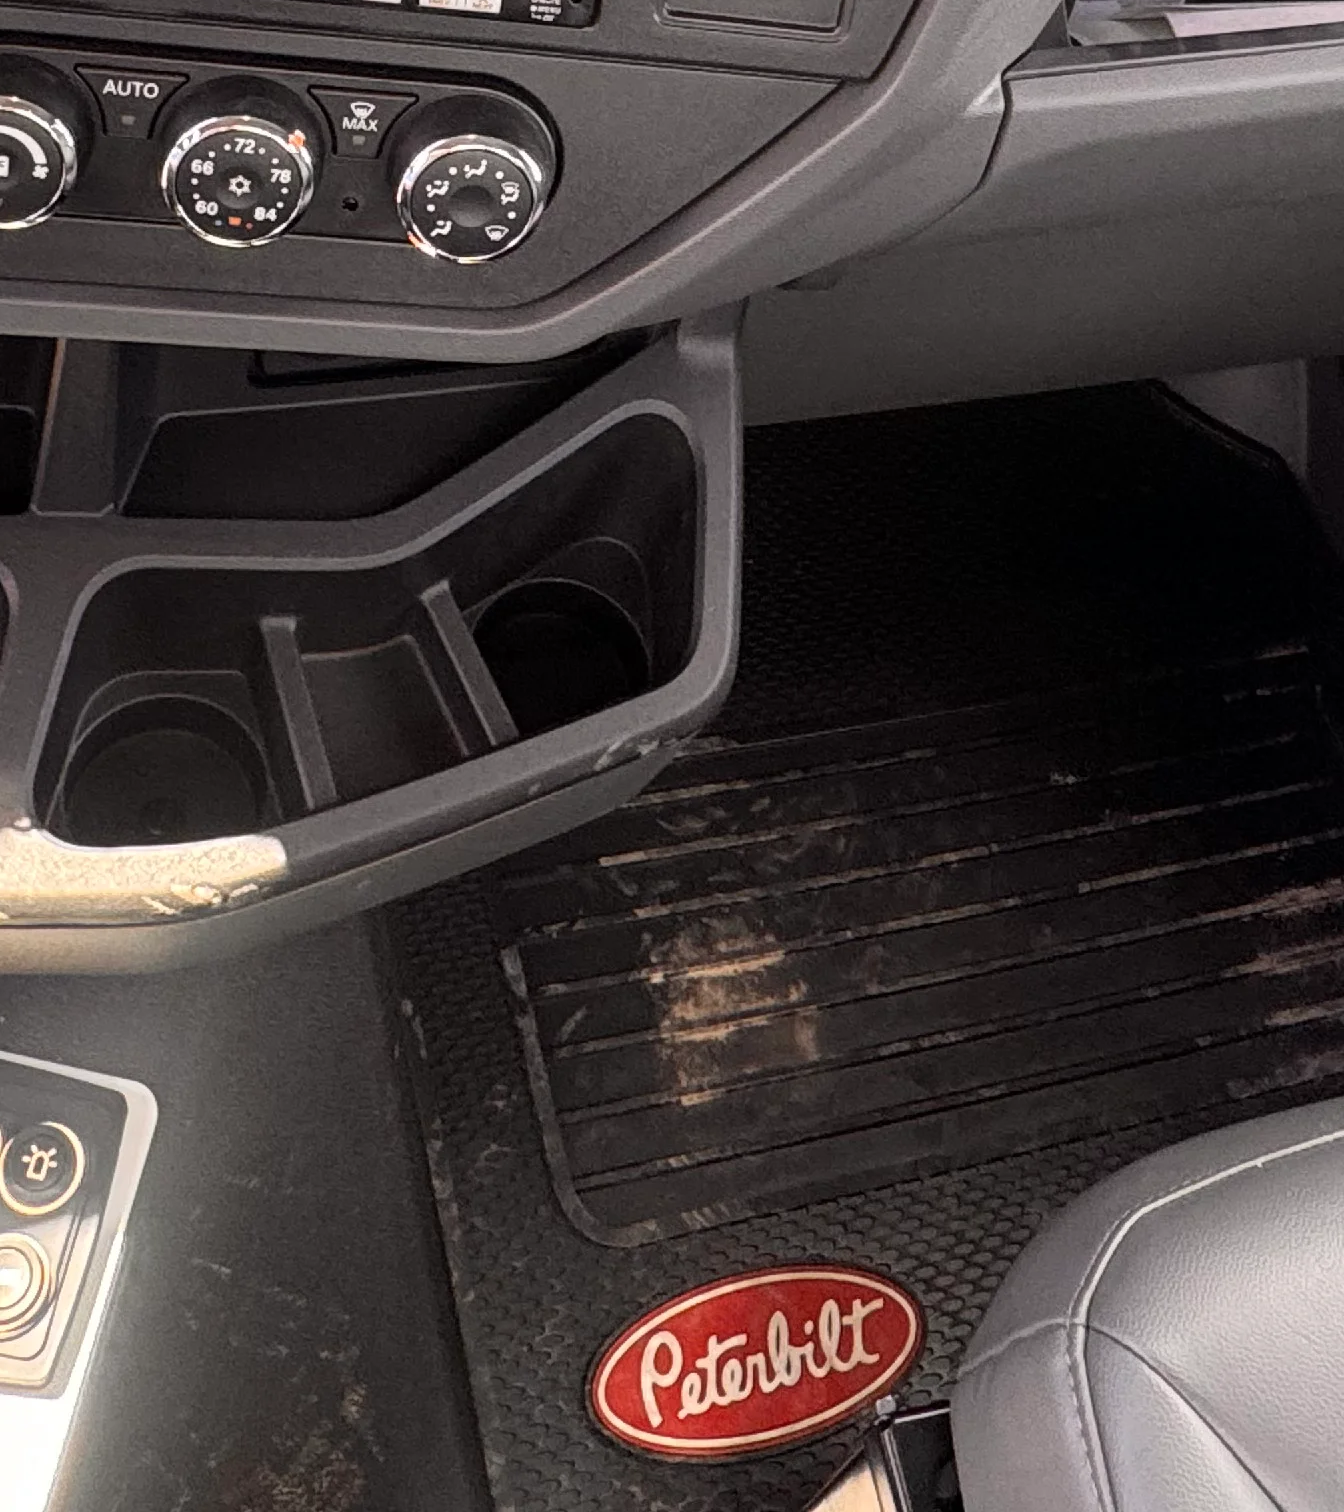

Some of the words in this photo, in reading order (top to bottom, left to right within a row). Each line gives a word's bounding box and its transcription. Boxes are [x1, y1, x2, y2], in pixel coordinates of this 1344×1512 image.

[102, 79, 159, 99] AUTO
[342, 117, 379, 132] MAX
[234, 138, 256, 154] 72
[191, 159, 214, 176] 66
[270, 169, 292, 184] 78
[195, 199, 219, 216] 60
[253, 207, 277, 222] 84
[641, 1298, 884, 1428] Peterbilt
